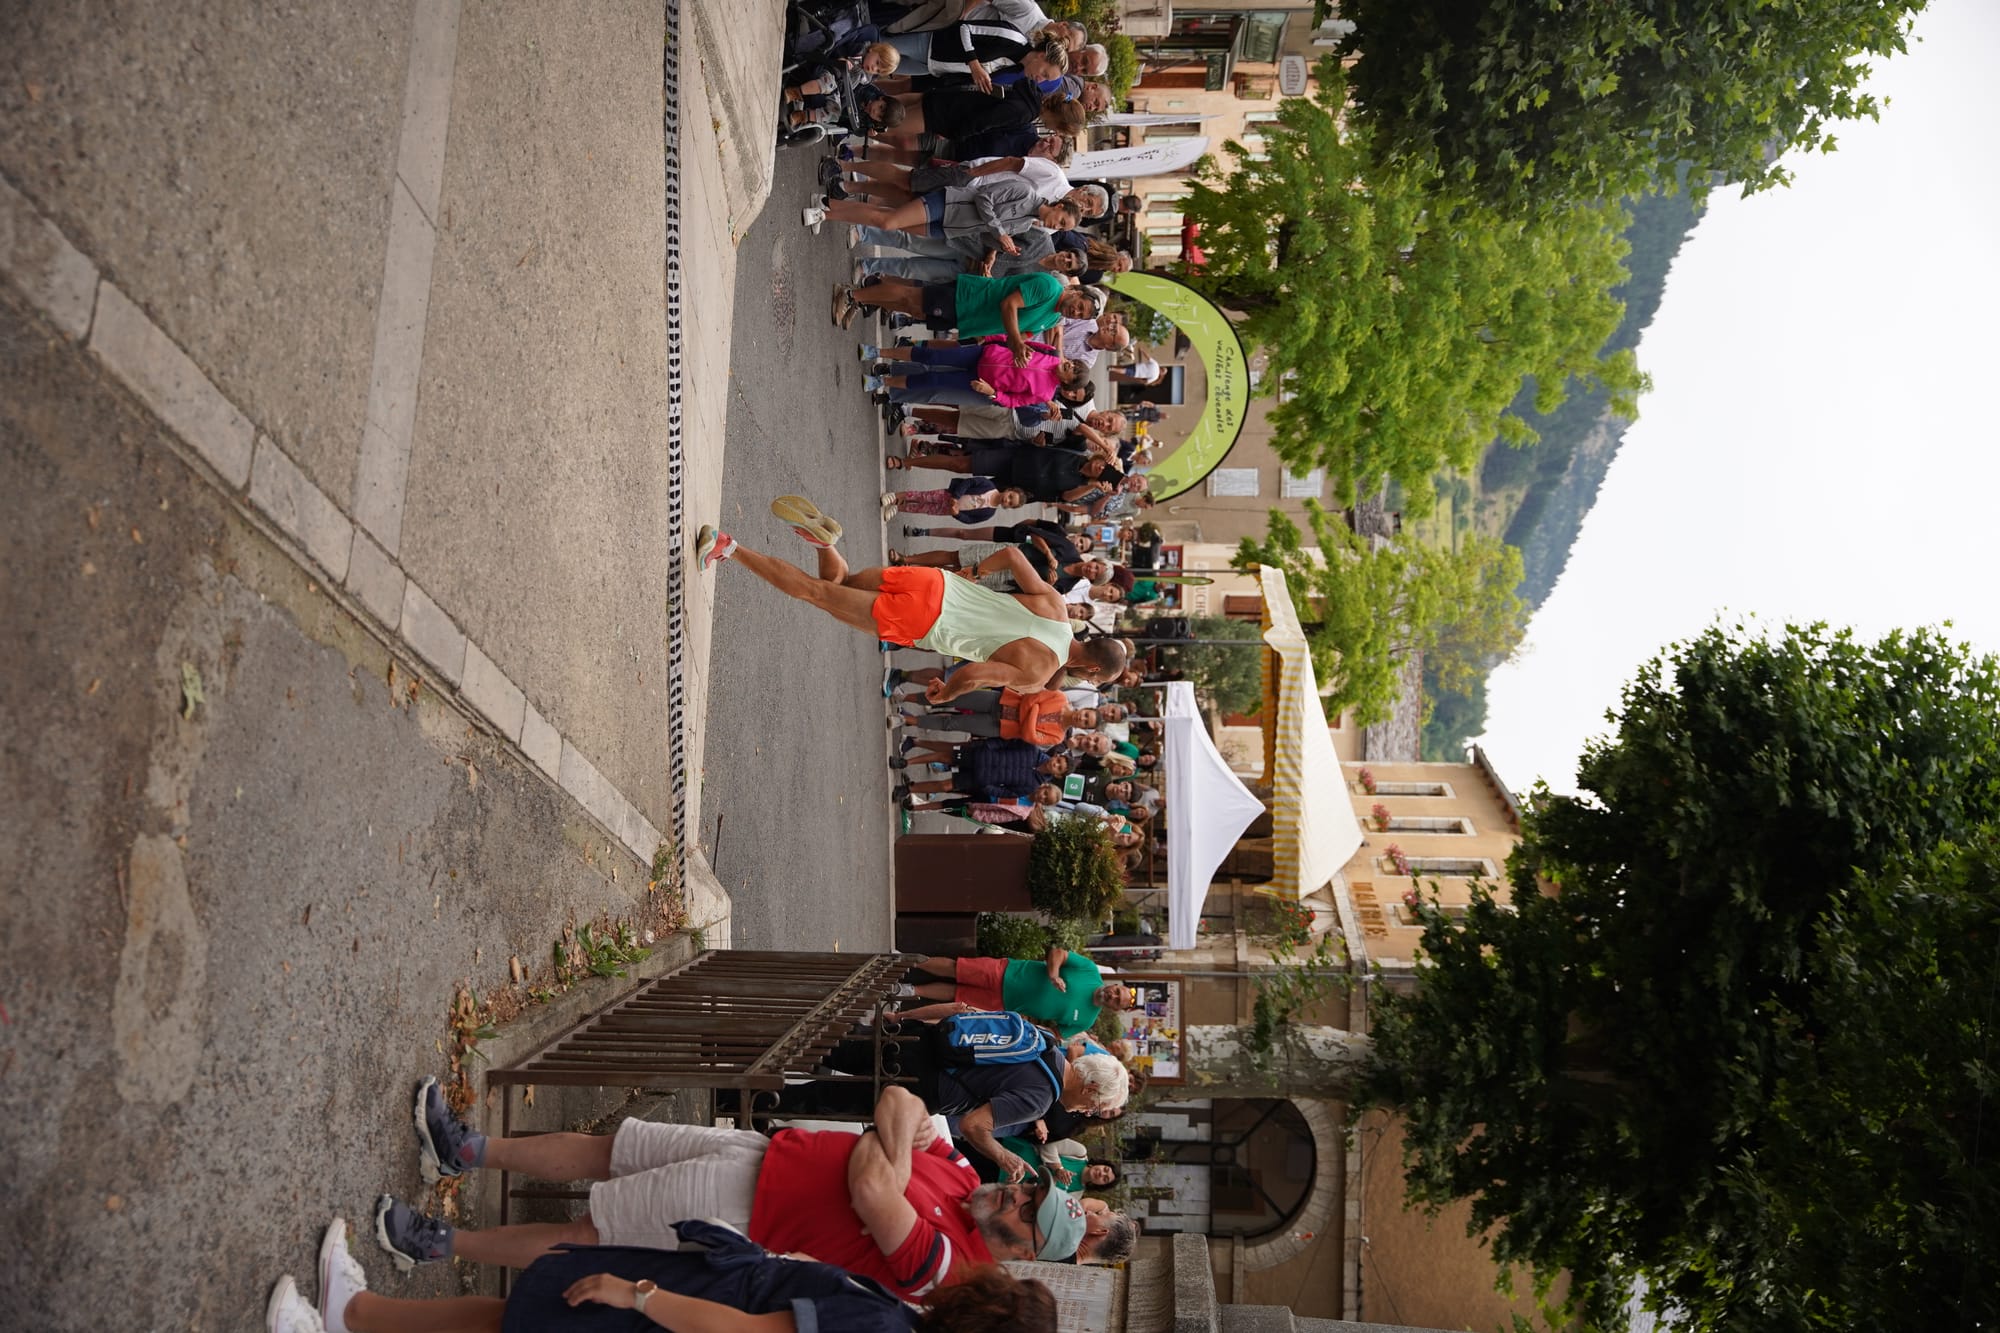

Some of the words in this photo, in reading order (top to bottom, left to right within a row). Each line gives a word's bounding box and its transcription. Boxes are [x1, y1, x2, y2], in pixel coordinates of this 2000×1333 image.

[1286, 60, 1301, 90] PIZZERIA
[1215, 340, 1224, 379] vallées
[1222, 347, 1234, 402] Challenge
[1215, 386, 1225, 433] cévenoles
[1226, 409, 1234, 427] des
[1352, 882, 1388, 936] MAIRIE
